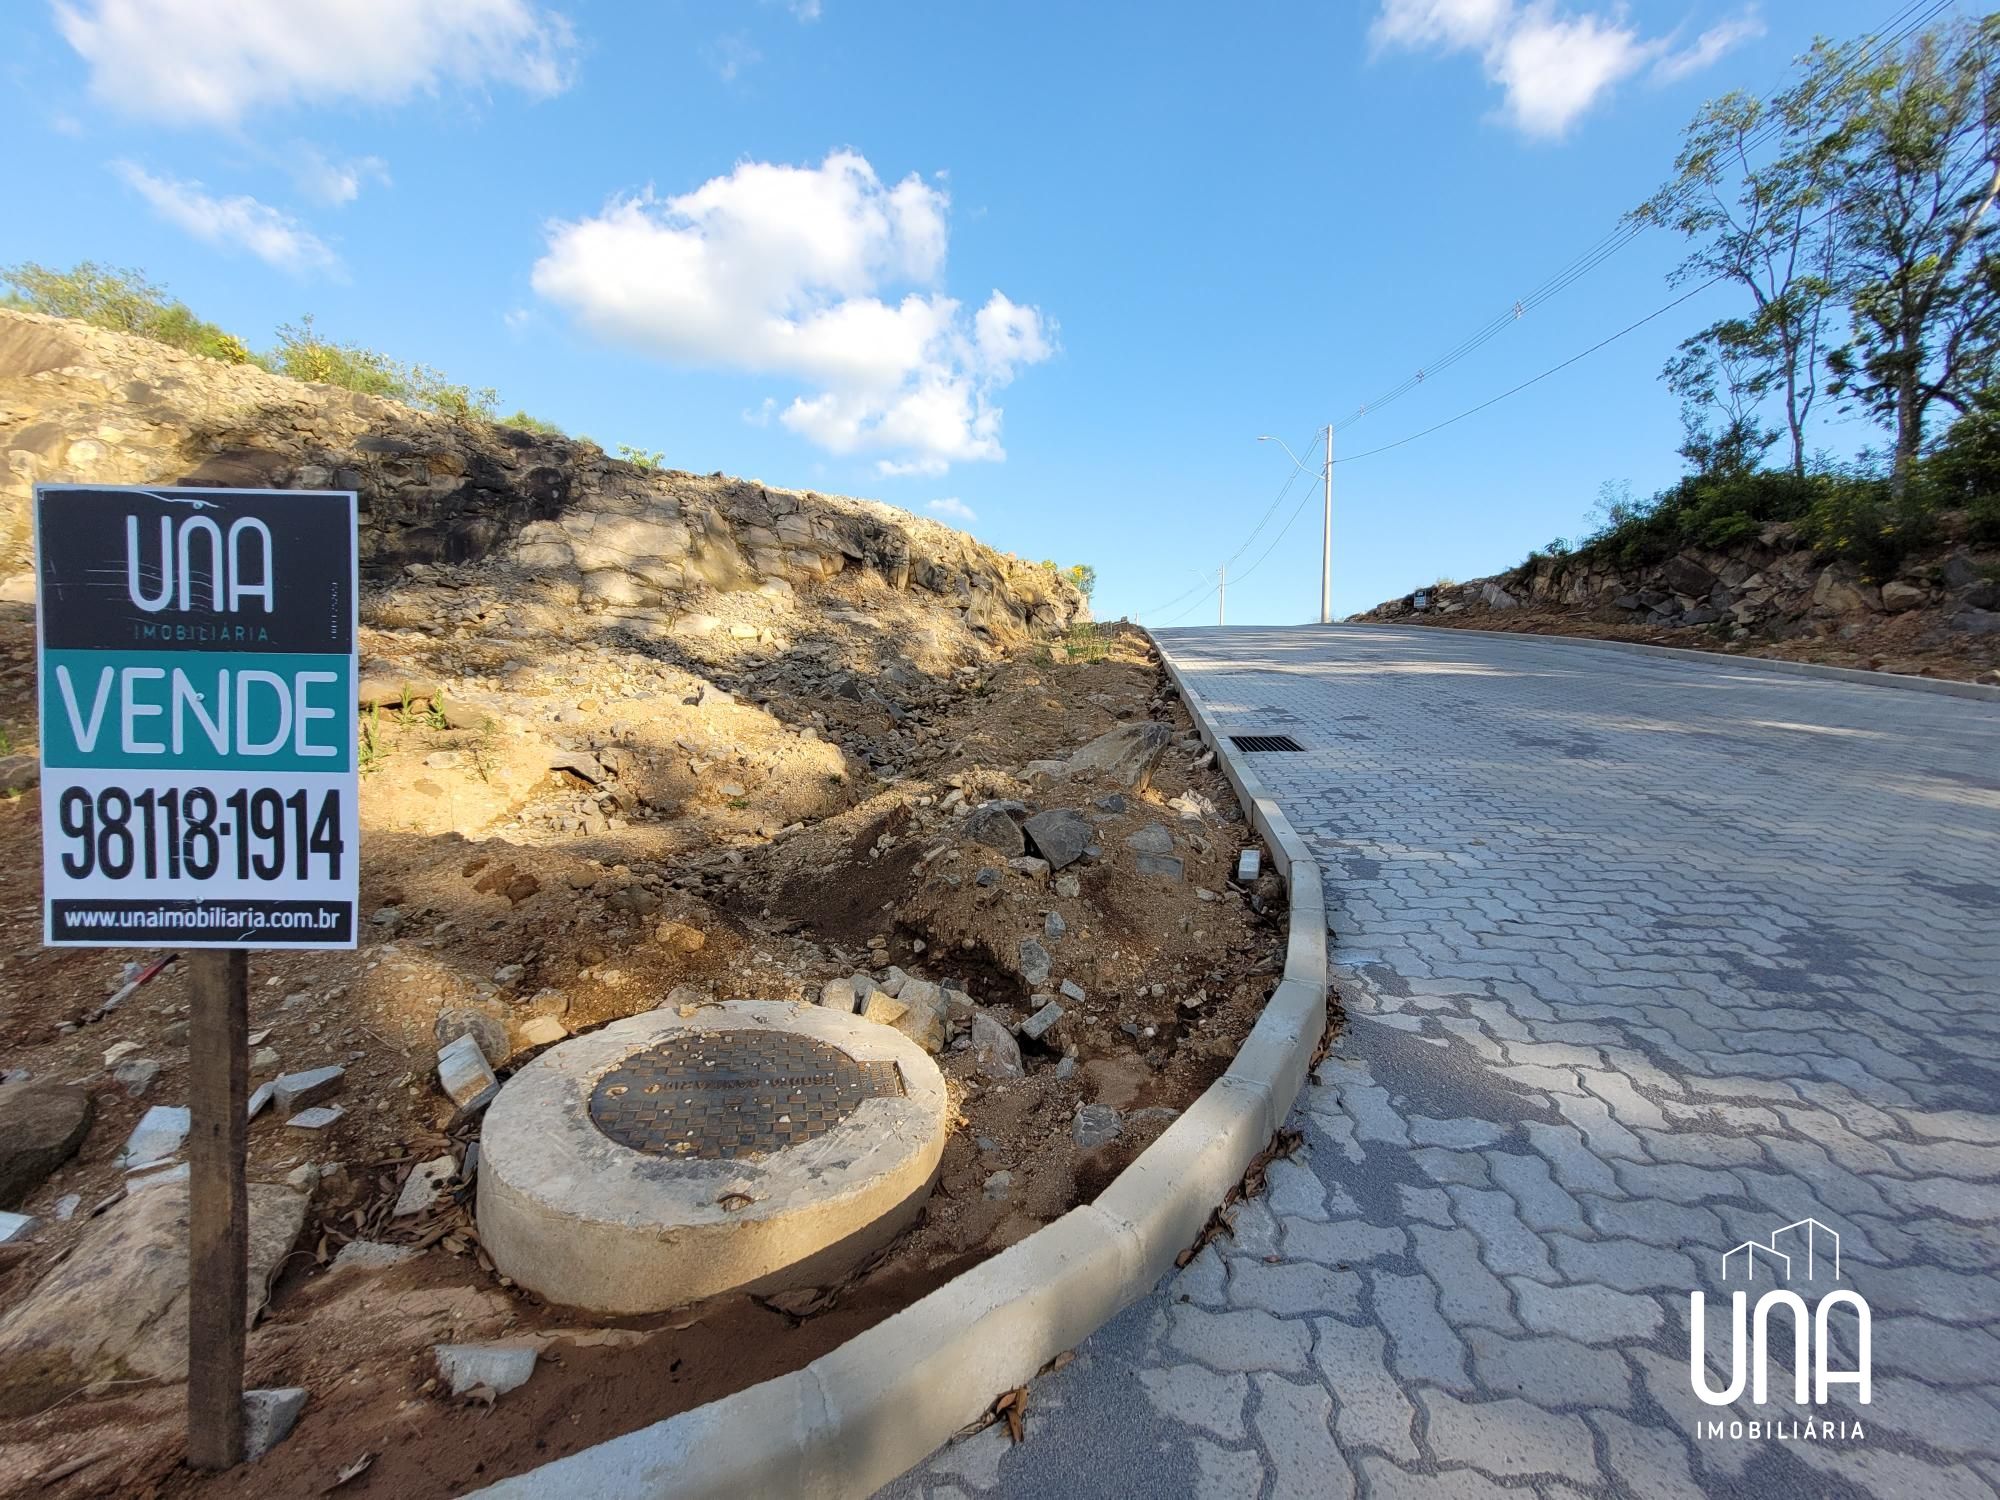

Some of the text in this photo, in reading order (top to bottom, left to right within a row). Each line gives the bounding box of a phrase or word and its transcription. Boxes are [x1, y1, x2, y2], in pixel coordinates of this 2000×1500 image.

[126, 515, 274, 613] UNA
[134, 623, 269, 641] IMOBILIÁRIA
[56, 665, 338, 756] VENDE
[60, 785, 344, 881] 98118-1914
[65, 907, 340, 930] www.unaimobiliaria.com.br
